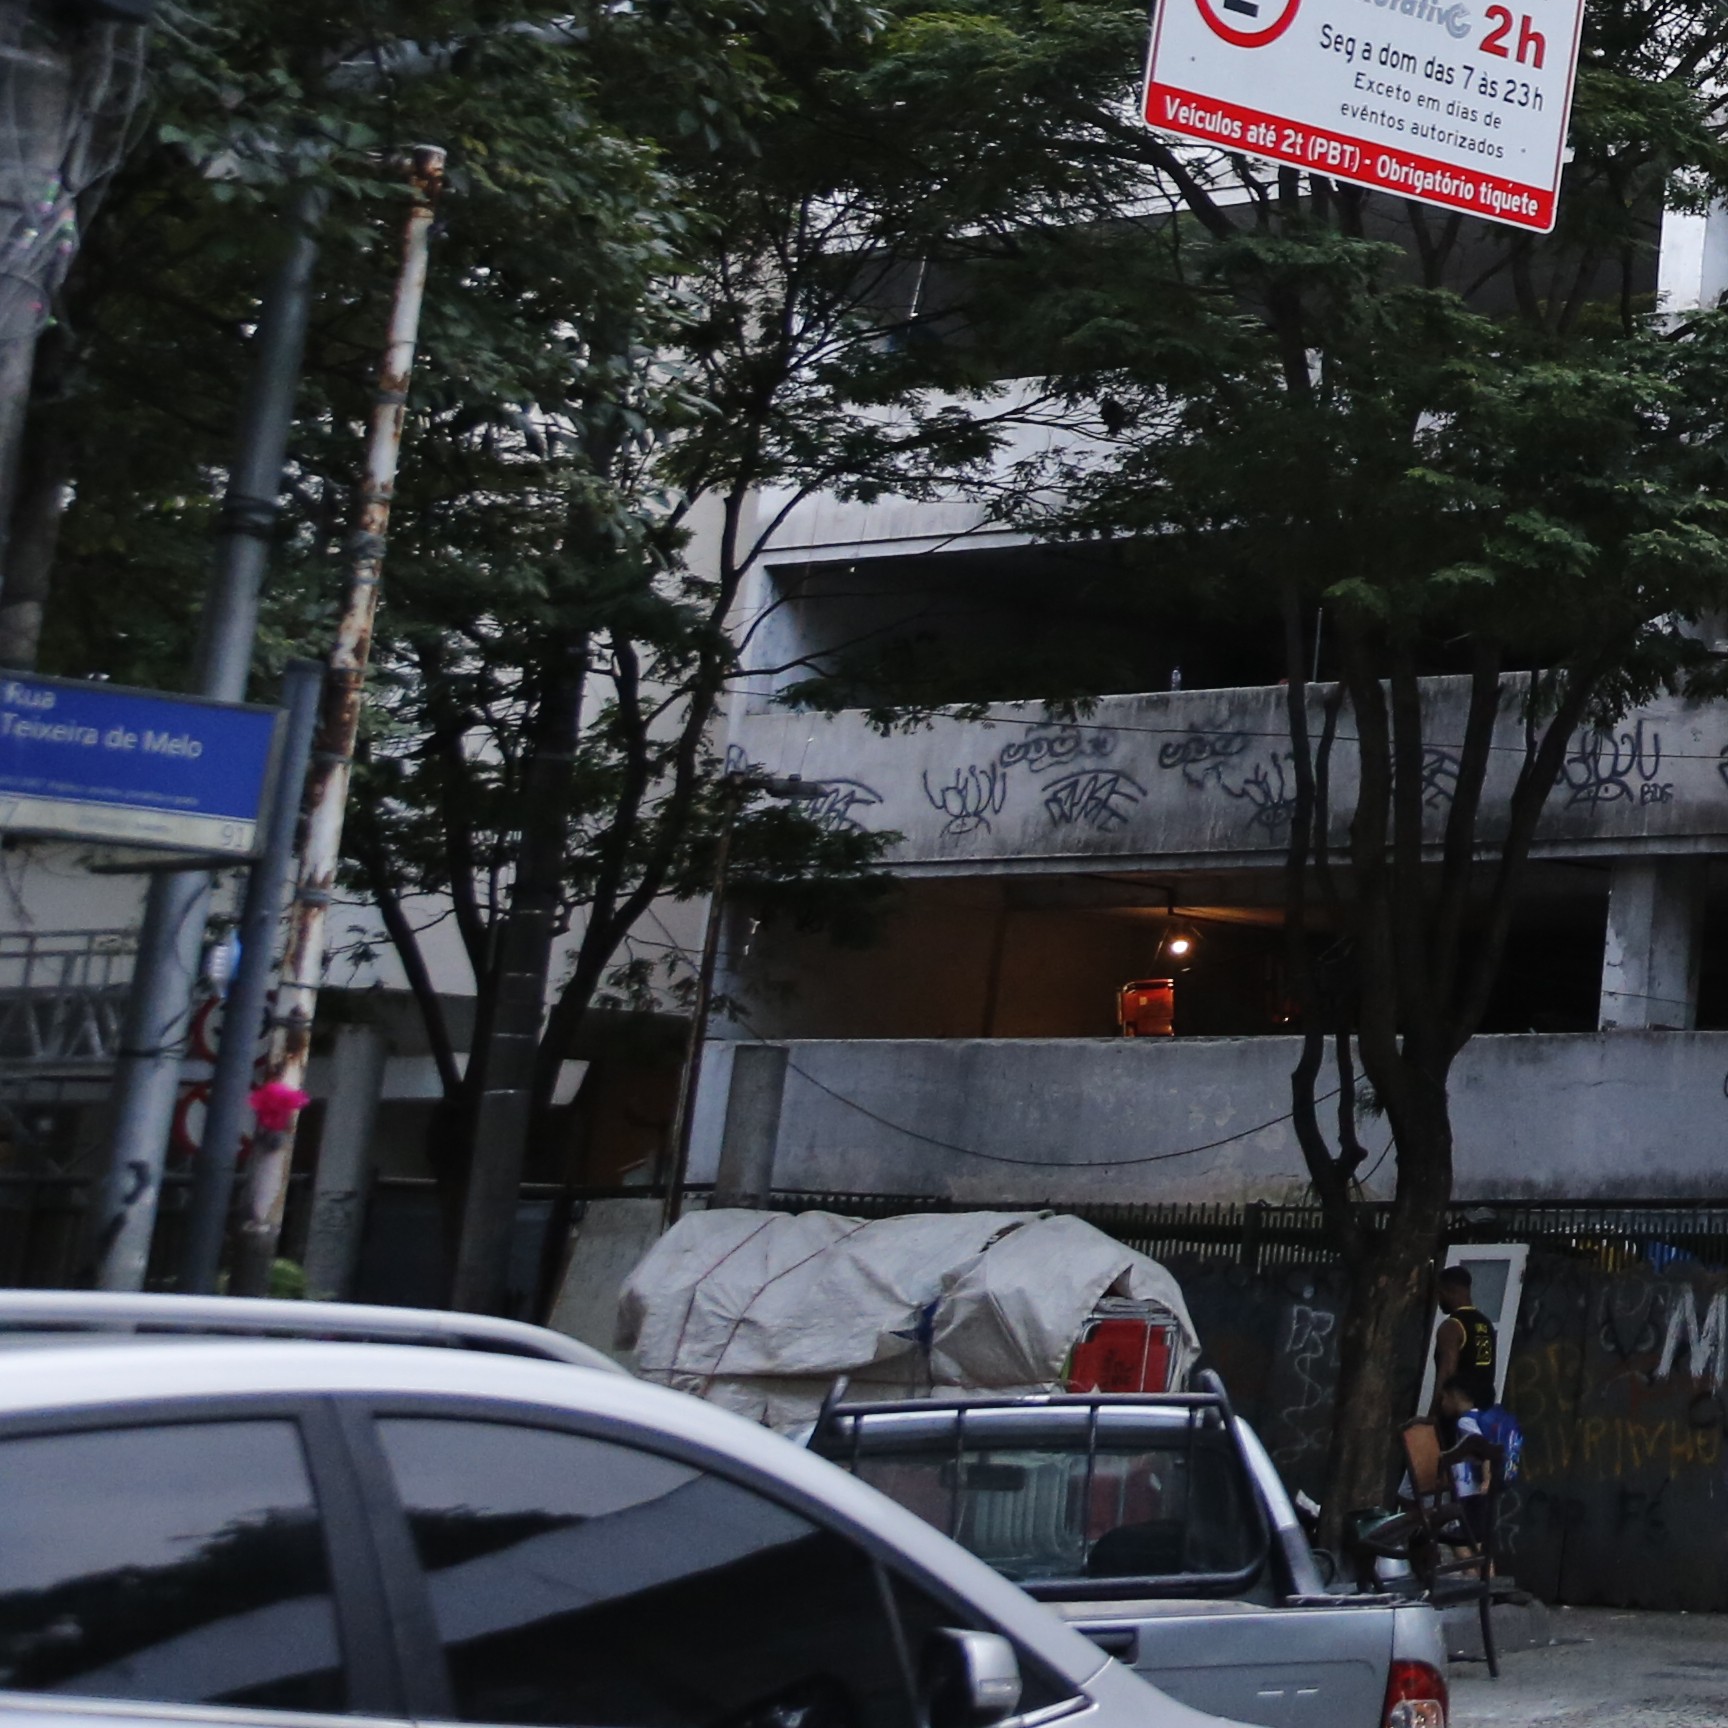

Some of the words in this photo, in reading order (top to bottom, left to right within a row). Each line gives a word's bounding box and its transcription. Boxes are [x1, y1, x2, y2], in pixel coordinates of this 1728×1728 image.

[1320, 24, 1355, 63] Seg
[1362, 42, 1372, 61] a
[1379, 43, 1417, 74] dom
[1424, 56, 1456, 85] das
[1462, 65, 1475, 90] 7
[1478, 71, 1498, 98] às
[1479, 4, 1546, 70] 2h
[1354, 71, 1412, 103] Exceto
[1417, 94, 1440, 112] em
[1446, 102, 1478, 123] dias
[1483, 111, 1502, 130] de
[1165, 95, 1242, 139] Veículos
[1246, 122, 1277, 148] até
[1280, 129, 1303, 156] 2t
[1307, 135, 1360, 173] (PBT)
[1377, 154, 1474, 200] Obrigatório
[1411, 121, 1504, 159] autorizados
[4, 682, 56, 709] Rua
[1, 712, 99, 745] Teixeira
[104, 725, 138, 749] de
[142, 730, 203, 758] Melo
